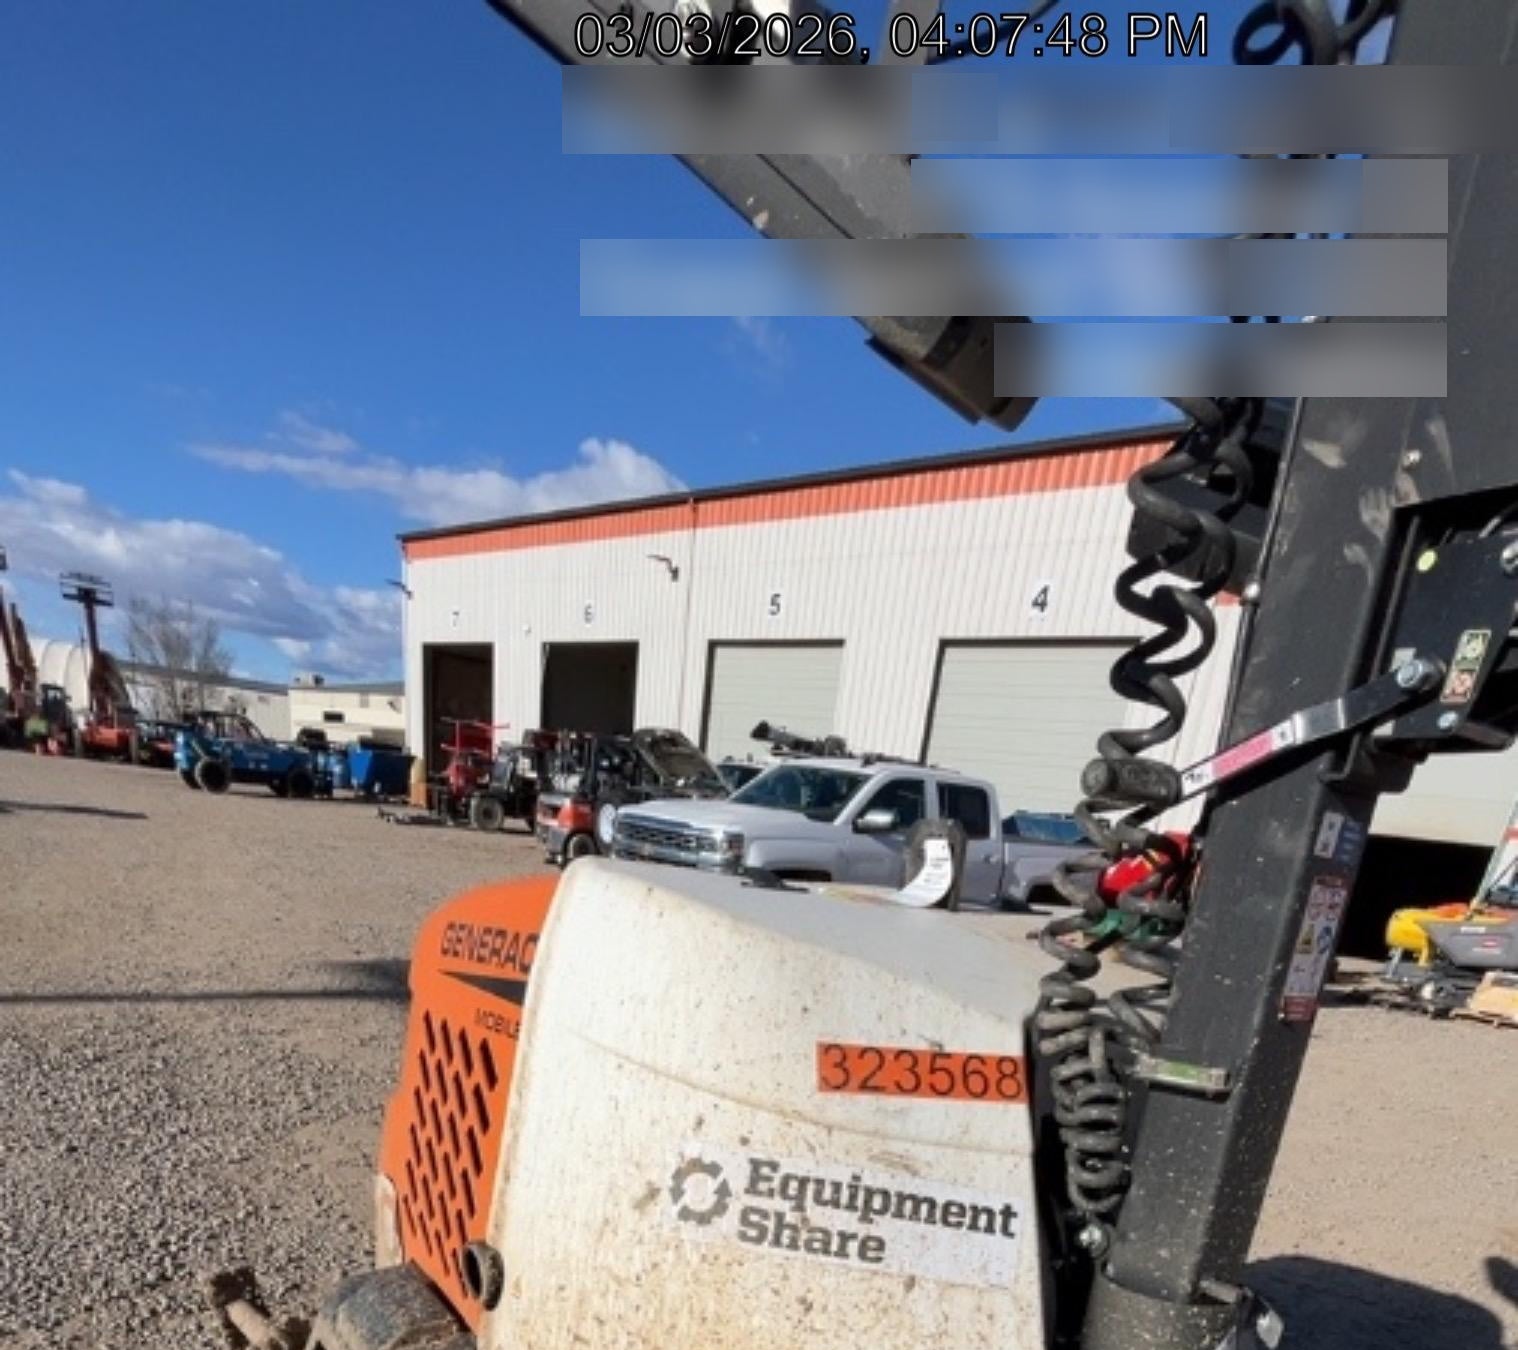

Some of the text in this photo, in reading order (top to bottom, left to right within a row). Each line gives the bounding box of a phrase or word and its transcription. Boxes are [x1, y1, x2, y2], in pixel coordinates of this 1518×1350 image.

[769, 593, 782, 616] 5
[1031, 585, 1050, 612] 4
[441, 920, 541, 976] GENERAC
[821, 1044, 1021, 1099] 323568
[743, 1157, 1018, 1239] Equipment
[736, 1205, 887, 1264] Share
